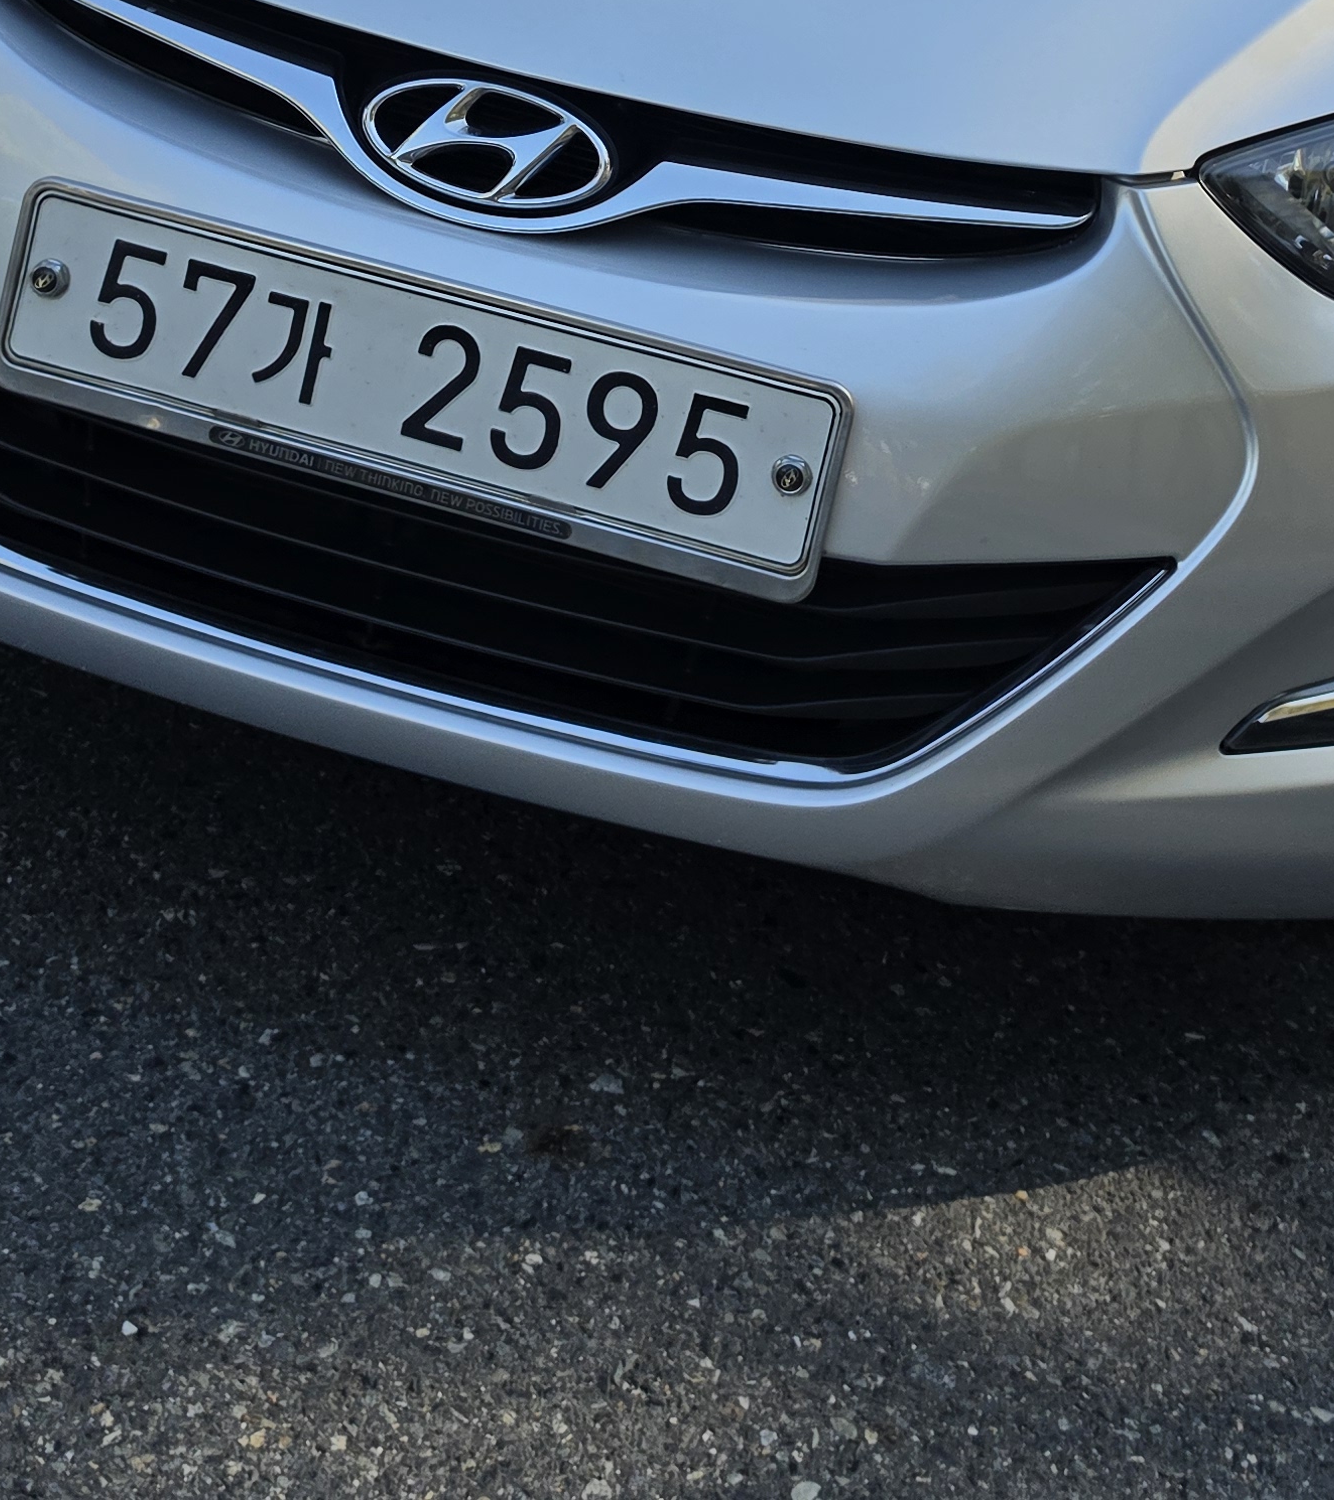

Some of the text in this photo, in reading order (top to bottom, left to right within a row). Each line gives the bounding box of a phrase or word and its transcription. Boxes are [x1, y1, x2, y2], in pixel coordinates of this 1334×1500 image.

[89, 239, 750, 516] 57가 2595
[249, 438, 315, 468] HYUNDAI
[325, 459, 357, 479] NEW
[431, 489, 463, 508] NEW
[466, 498, 564, 536] POSSIBILITIES.
